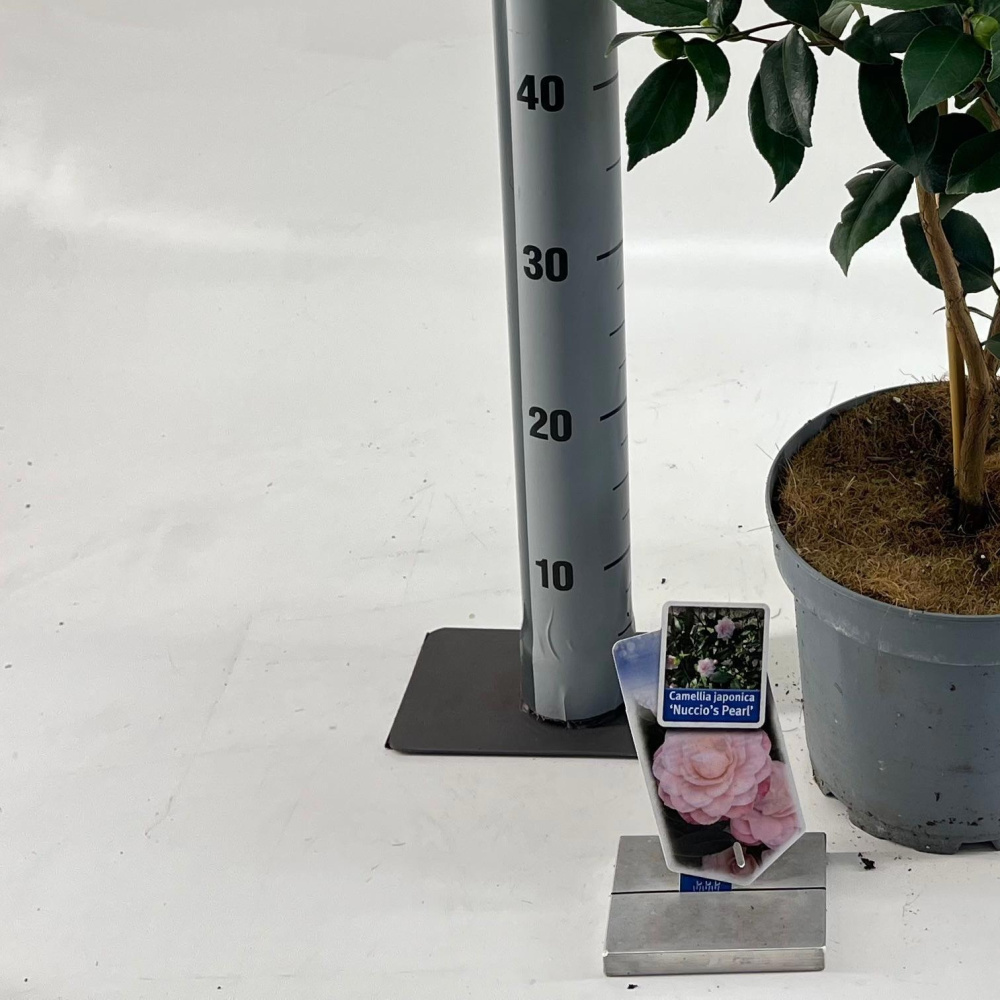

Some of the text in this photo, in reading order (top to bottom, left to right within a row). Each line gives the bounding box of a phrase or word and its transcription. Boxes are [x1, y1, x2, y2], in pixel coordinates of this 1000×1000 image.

[516, 74, 565, 113] 40
[522, 245, 569, 283] 30
[528, 406, 573, 443] 20
[535, 558, 574, 592] 10
[669, 691, 755, 703] Camellia japonica
